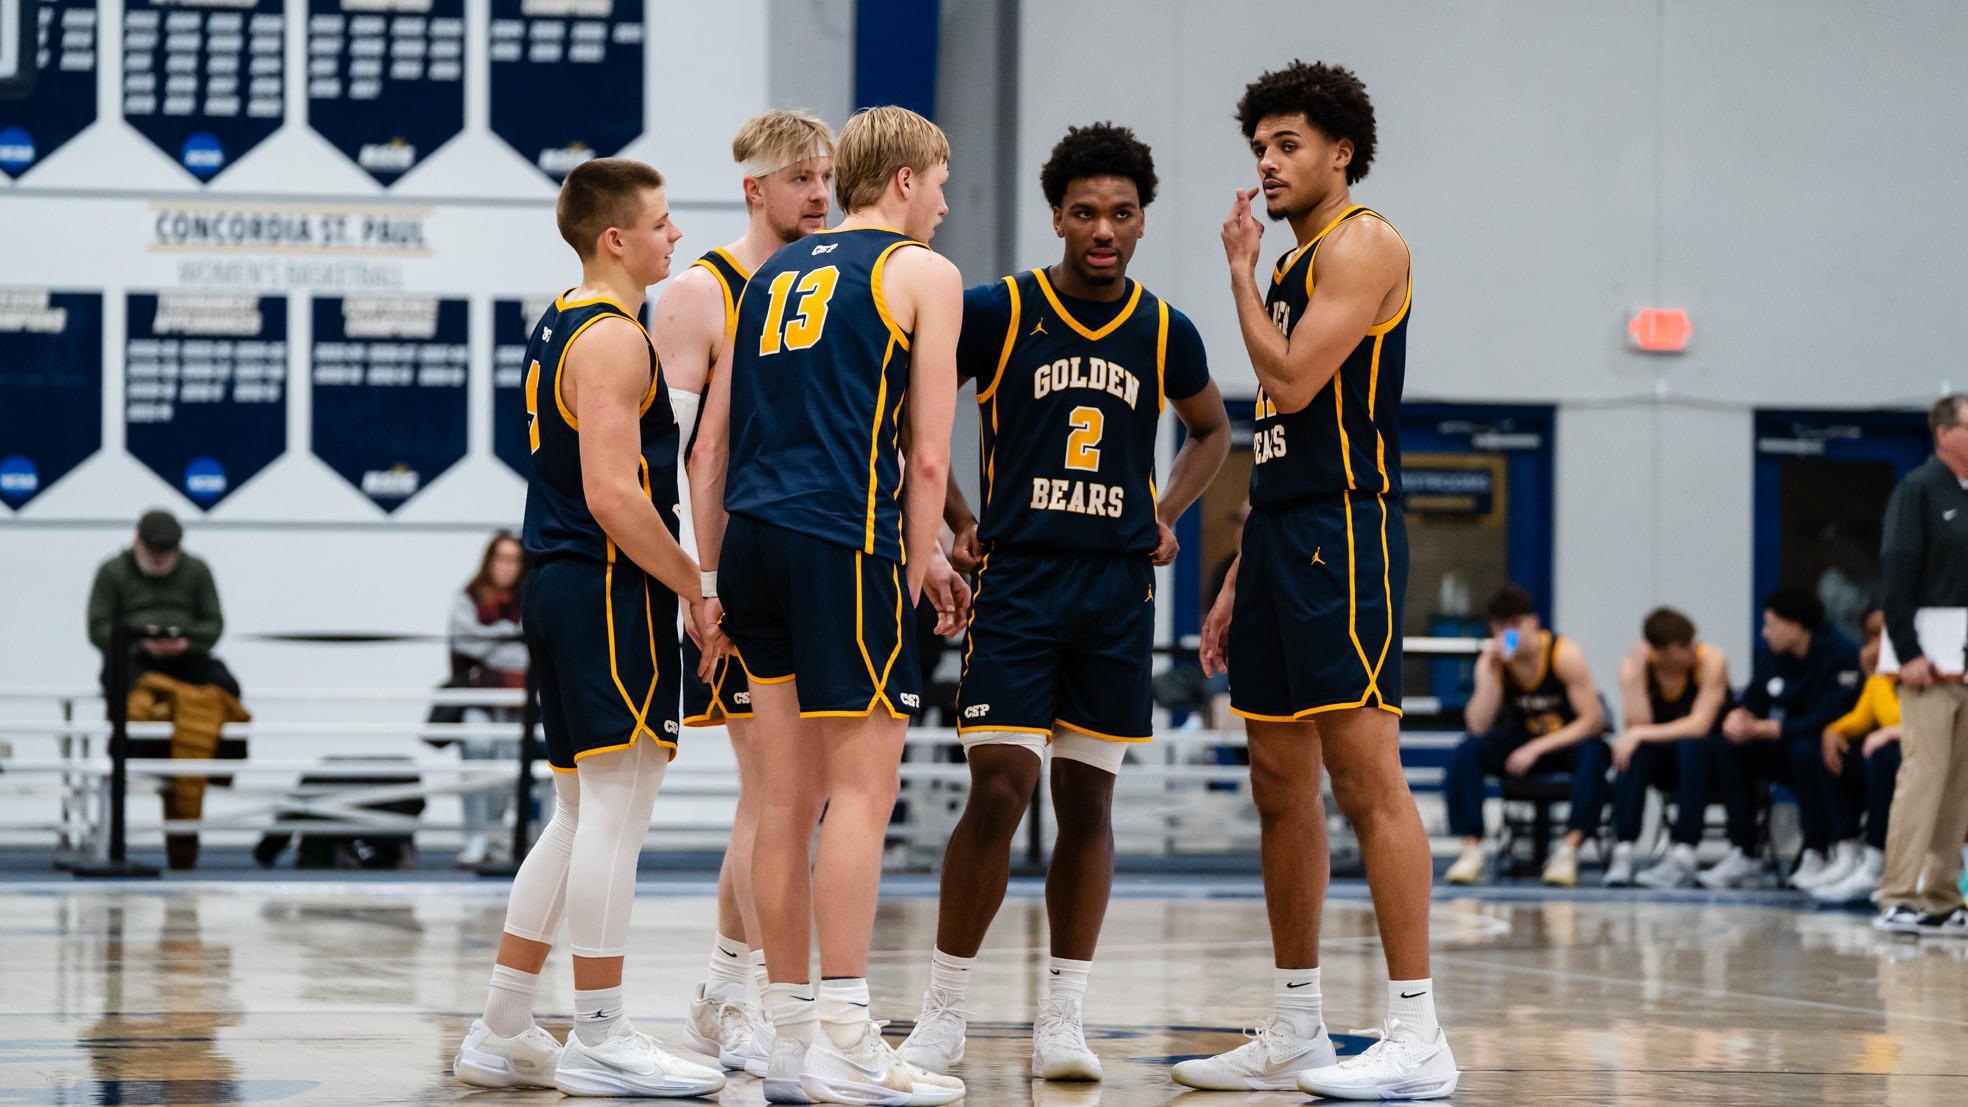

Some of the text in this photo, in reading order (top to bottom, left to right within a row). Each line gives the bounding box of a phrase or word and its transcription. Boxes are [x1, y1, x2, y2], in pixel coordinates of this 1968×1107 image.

[155, 211, 312, 244] CONCORDIA
[361, 218, 426, 248] PAUL
[759, 265, 840, 357] 13
[1034, 356, 1140, 411] GOLDEN
[1064, 405, 1105, 472] 2
[1030, 477, 1124, 518] BEARS
[733, 691, 751, 705] CS
[964, 703, 990, 719] CSP
